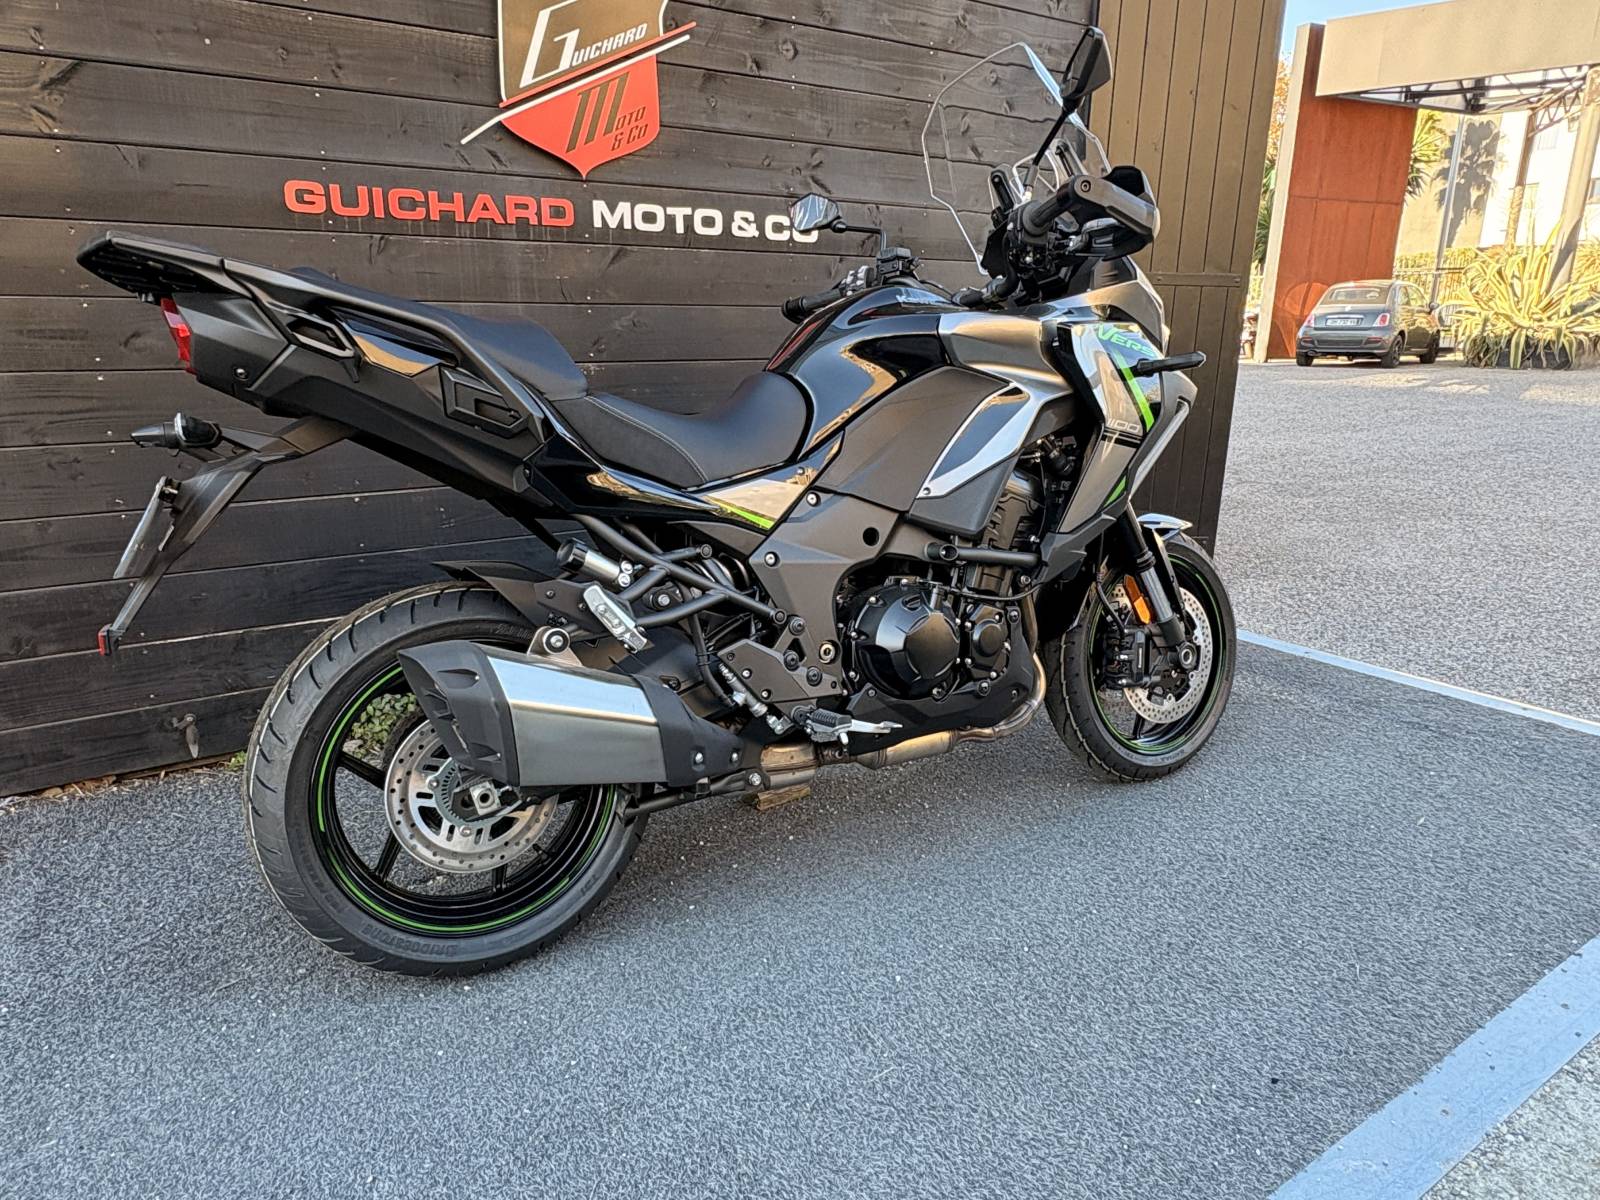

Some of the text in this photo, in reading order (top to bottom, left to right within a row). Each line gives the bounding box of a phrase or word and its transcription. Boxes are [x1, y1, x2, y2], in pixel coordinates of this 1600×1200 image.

[519, 0, 648, 89] GUICHARD
[565, 71, 646, 154] MOTO
[283, 179, 575, 227] GUICHARD
[592, 200, 723, 236] MOTO
